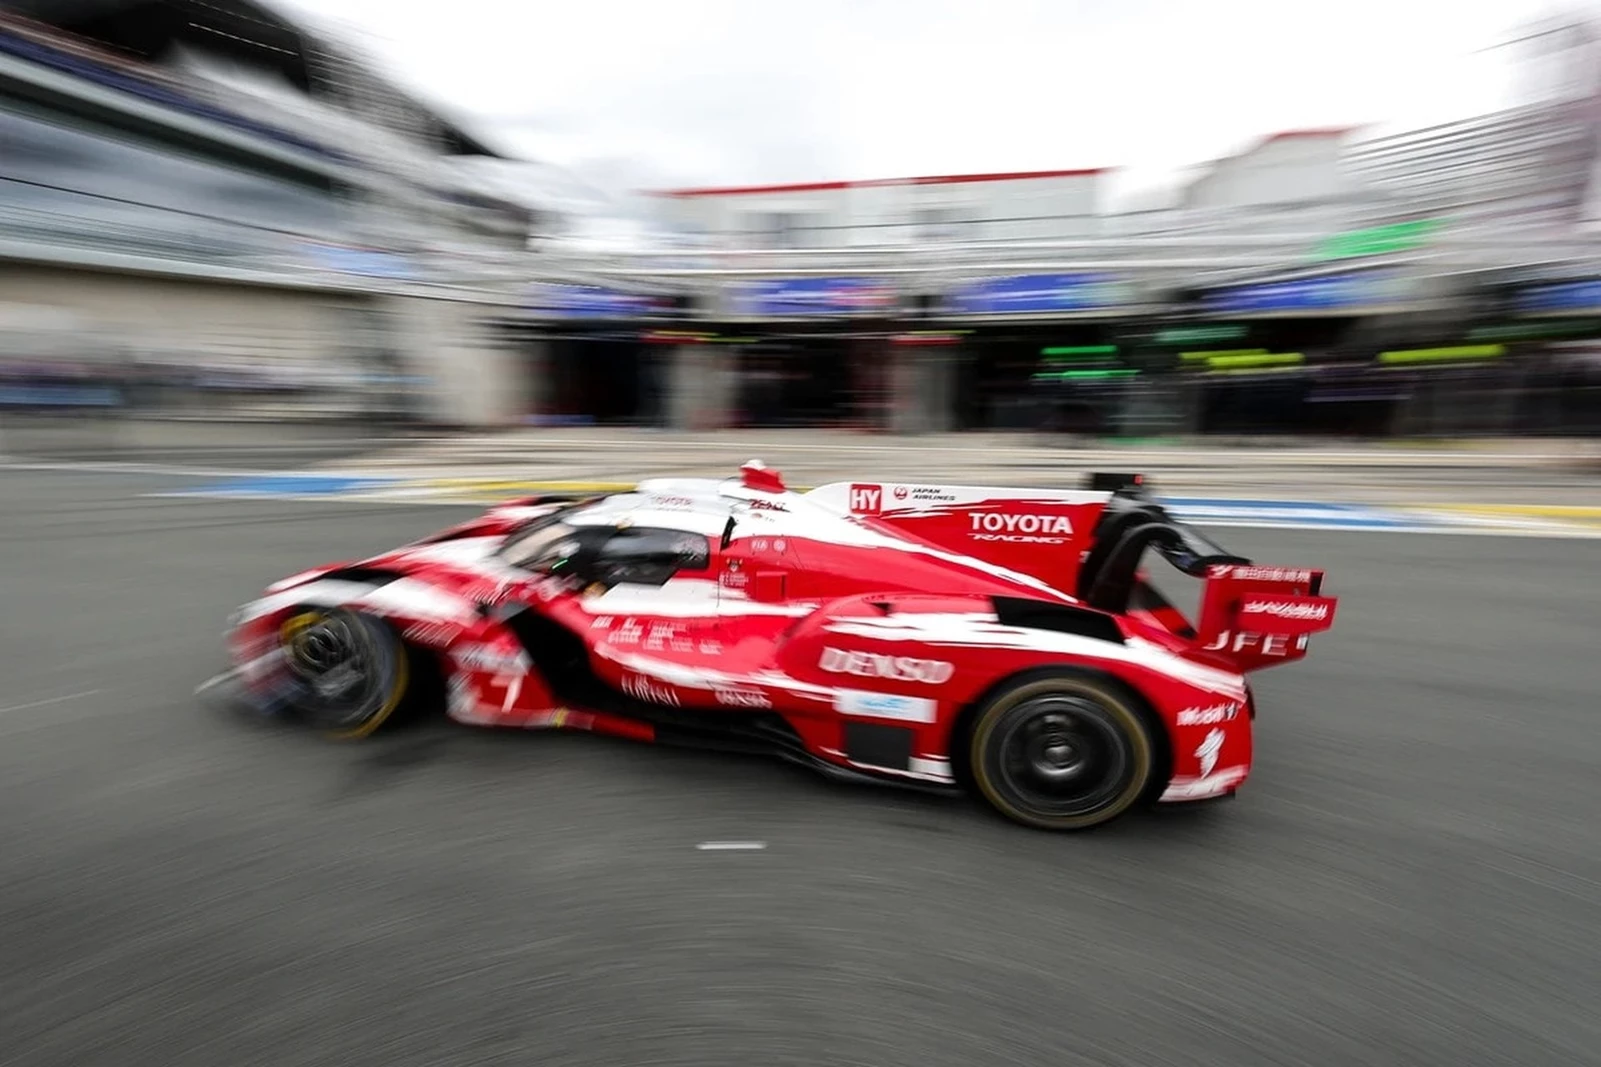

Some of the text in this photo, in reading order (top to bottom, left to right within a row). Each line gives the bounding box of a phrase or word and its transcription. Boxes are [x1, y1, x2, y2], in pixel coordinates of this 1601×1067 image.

[851, 488, 881, 511] HY
[968, 512, 1074, 535] TOYOTA
[966, 532, 1073, 544] RACING
[1202, 629, 1290, 657] JFE
